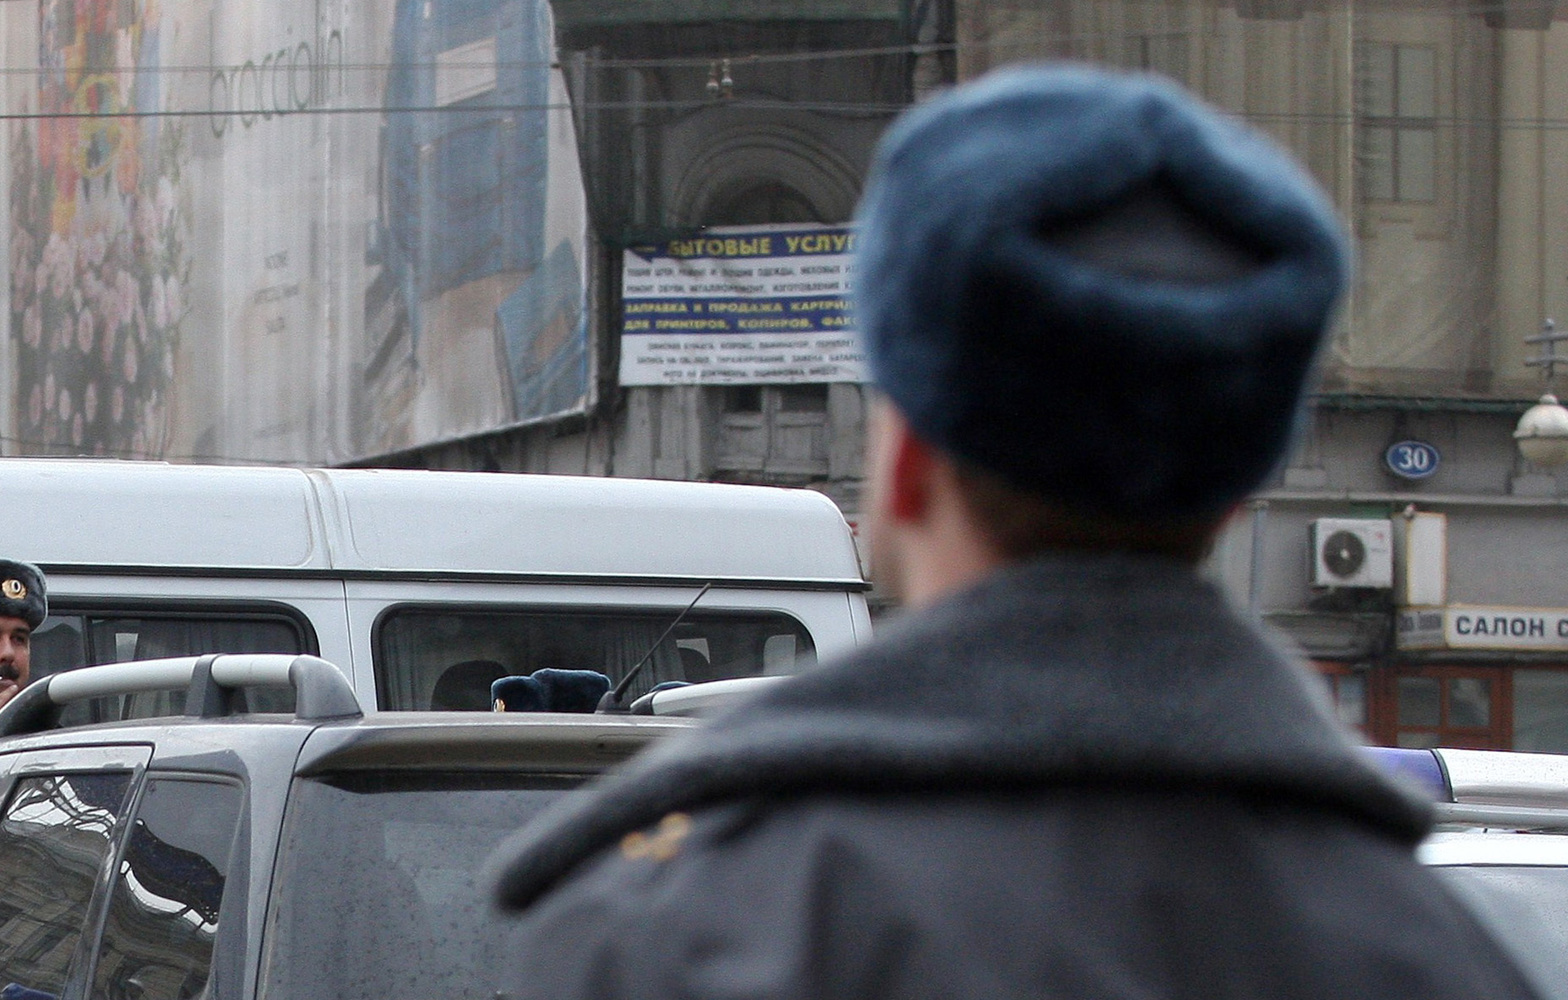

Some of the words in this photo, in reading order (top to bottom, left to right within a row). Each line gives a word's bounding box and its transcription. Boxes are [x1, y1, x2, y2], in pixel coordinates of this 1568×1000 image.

[668, 236, 772, 257] БЫТОВЫЕ
[707, 301, 784, 314] ПРОДАЖА
[1398, 446, 1429, 471] 30
[1456, 615, 1545, 638] САЛОН
